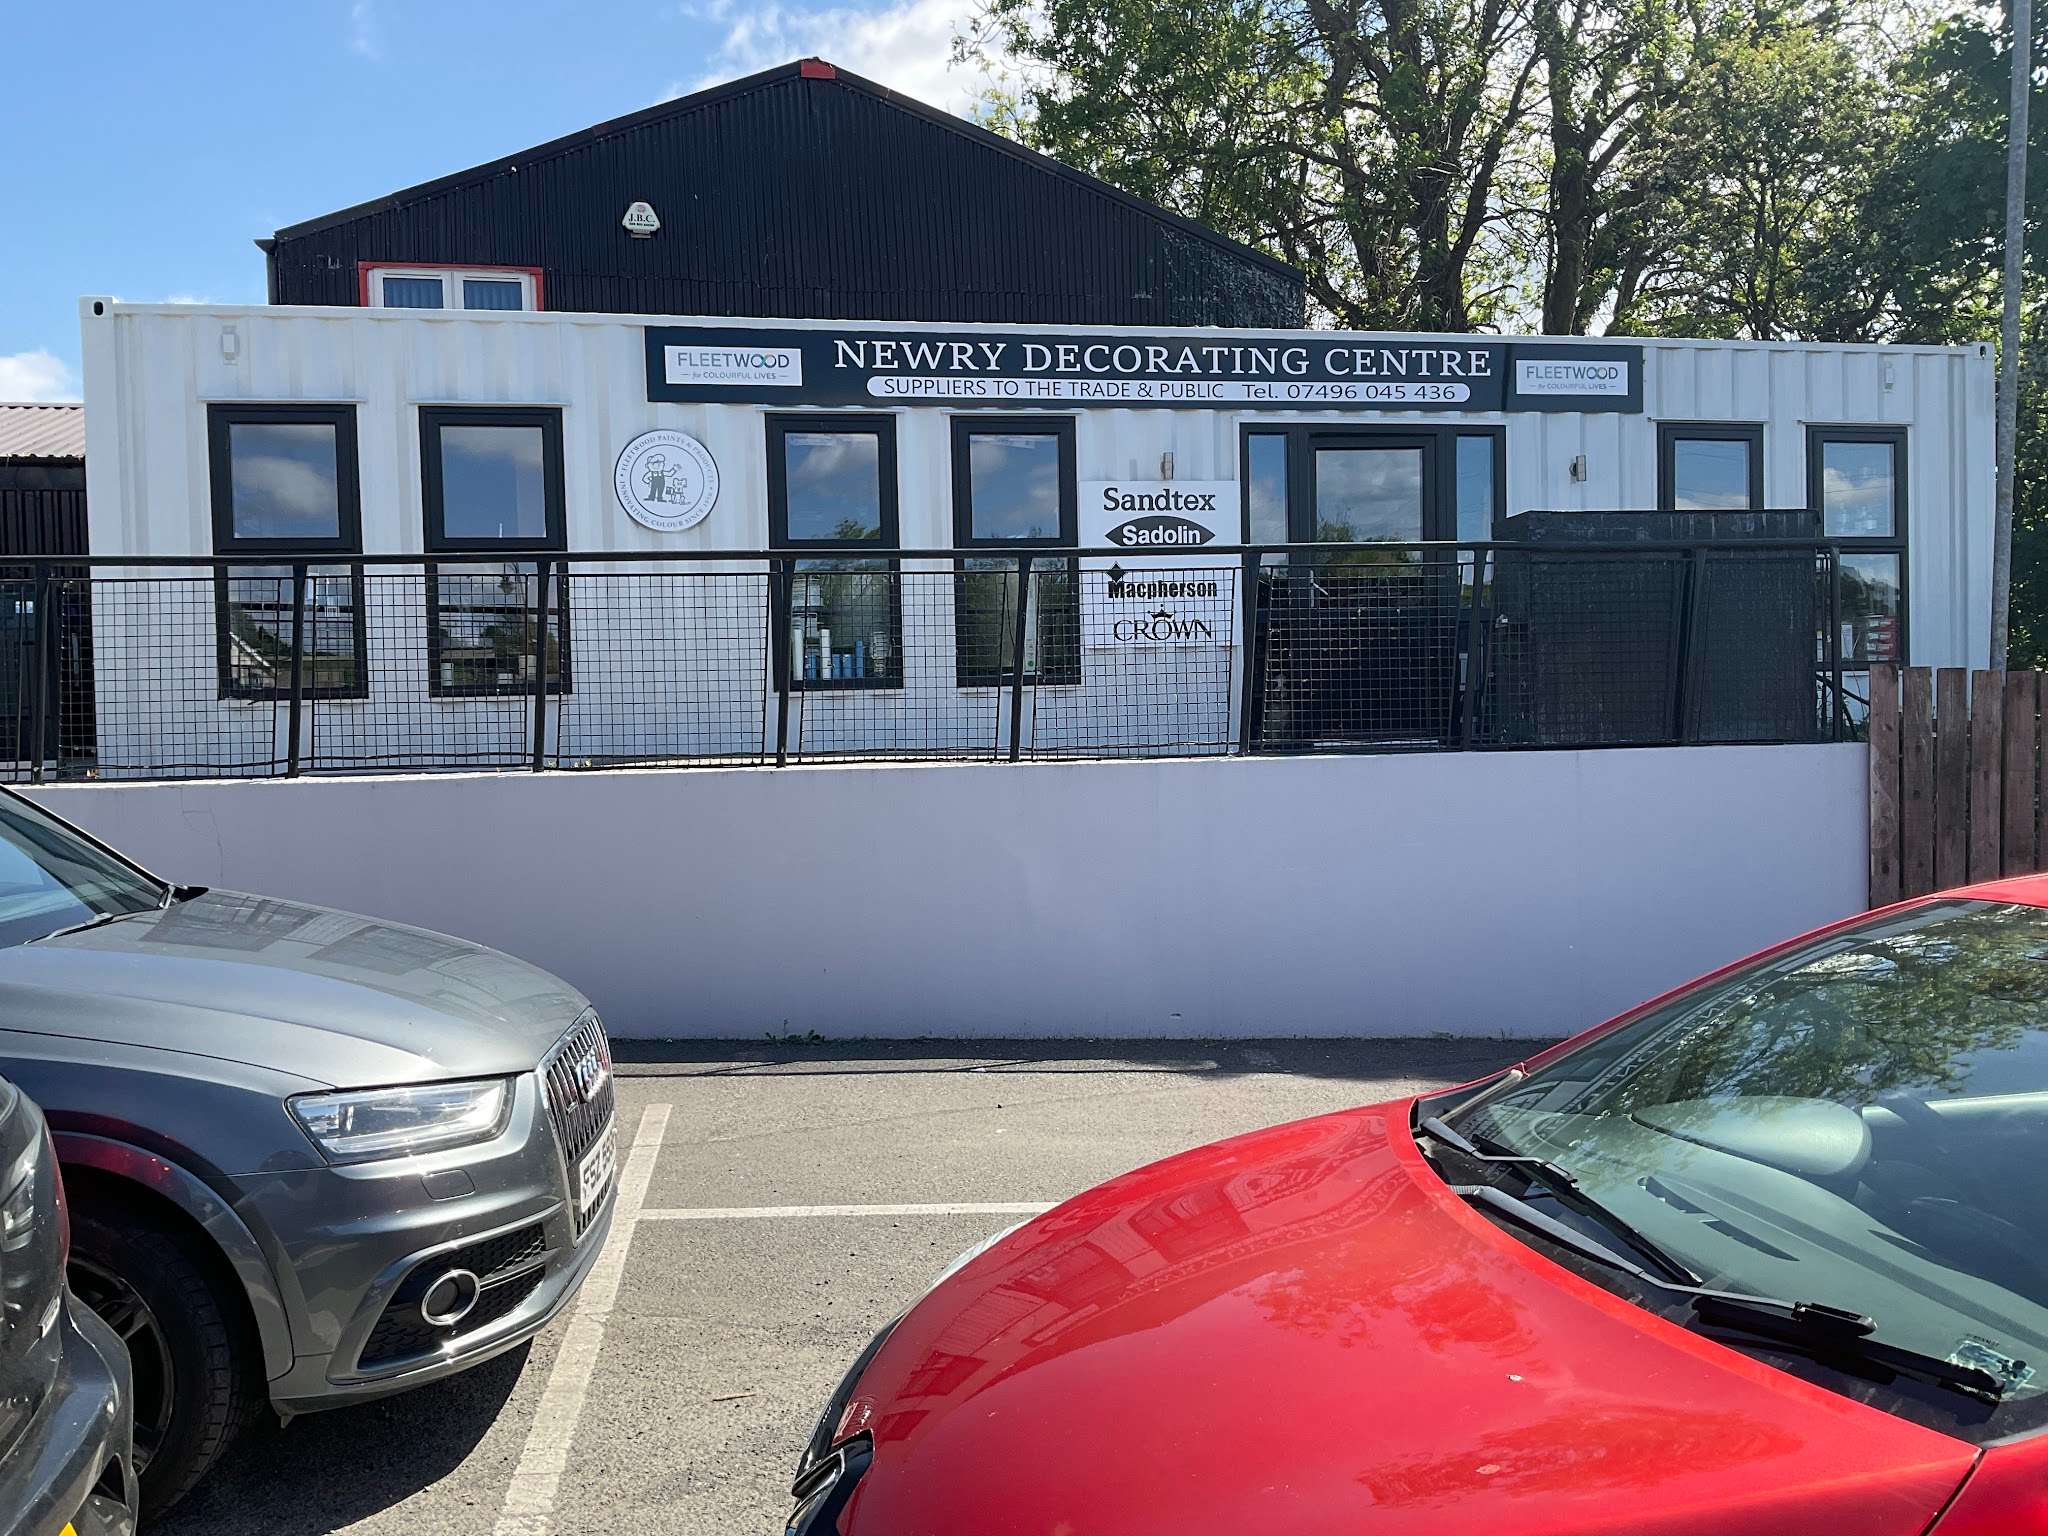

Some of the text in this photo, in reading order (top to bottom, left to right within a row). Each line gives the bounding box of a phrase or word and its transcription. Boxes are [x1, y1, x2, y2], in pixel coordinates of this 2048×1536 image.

[677, 352, 790, 369] FLEETWOOD
[833, 339, 1491, 377] NEWRY DECORATING CENTRE
[754, 372, 777, 380] LIVES
[1526, 365, 1618, 380] FLEETWOOD
[884, 378, 1455, 400] SUPPLIERS TO THE TRADE & PUBLIC Tel. 07496 045 436
[1103, 487, 1216, 511] Sandtex
[1122, 525, 1201, 545] Sadolin
[1107, 580, 1218, 599] Macpherson
[1113, 619, 1212, 641] CROWN
